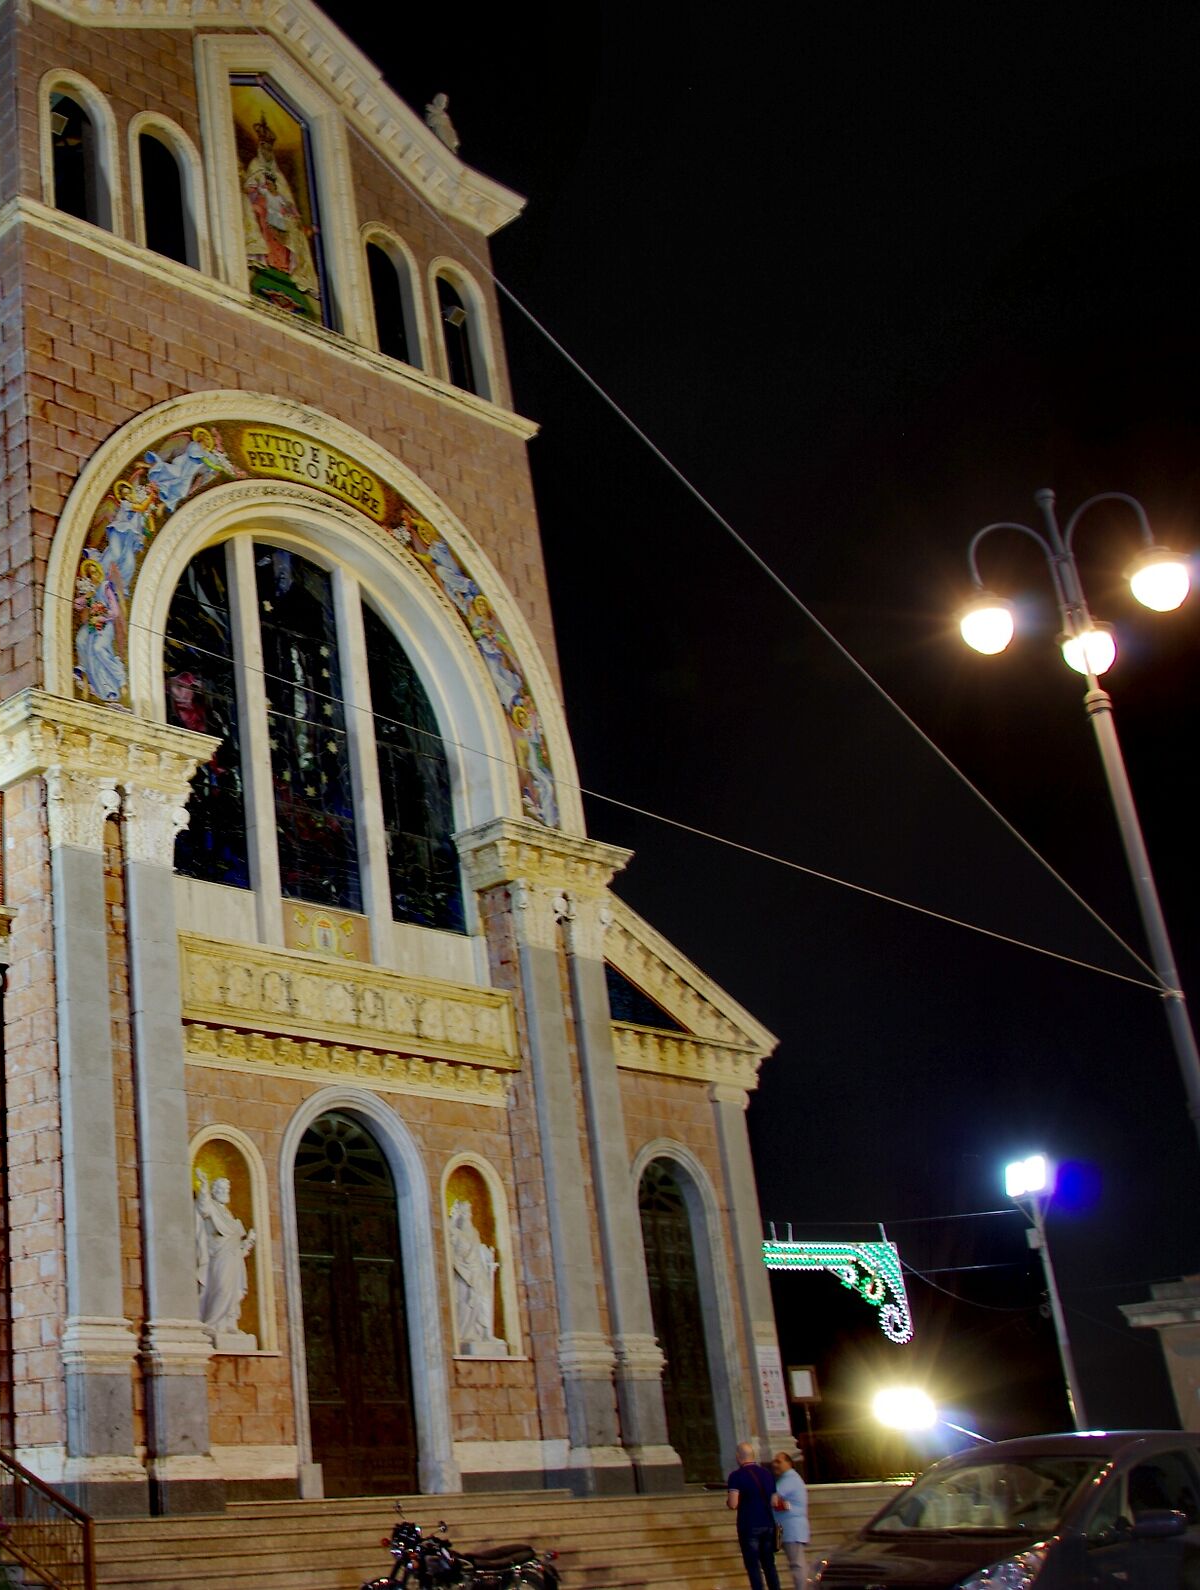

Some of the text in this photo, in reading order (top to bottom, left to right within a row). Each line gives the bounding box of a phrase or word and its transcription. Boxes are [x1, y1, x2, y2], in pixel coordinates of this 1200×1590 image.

[247, 450, 278, 467] PER
[306, 463, 319, 479] O
[324, 469, 380, 514] MADRE
[248, 432, 305, 457] TVTTO
[327, 454, 373, 491] POCO
